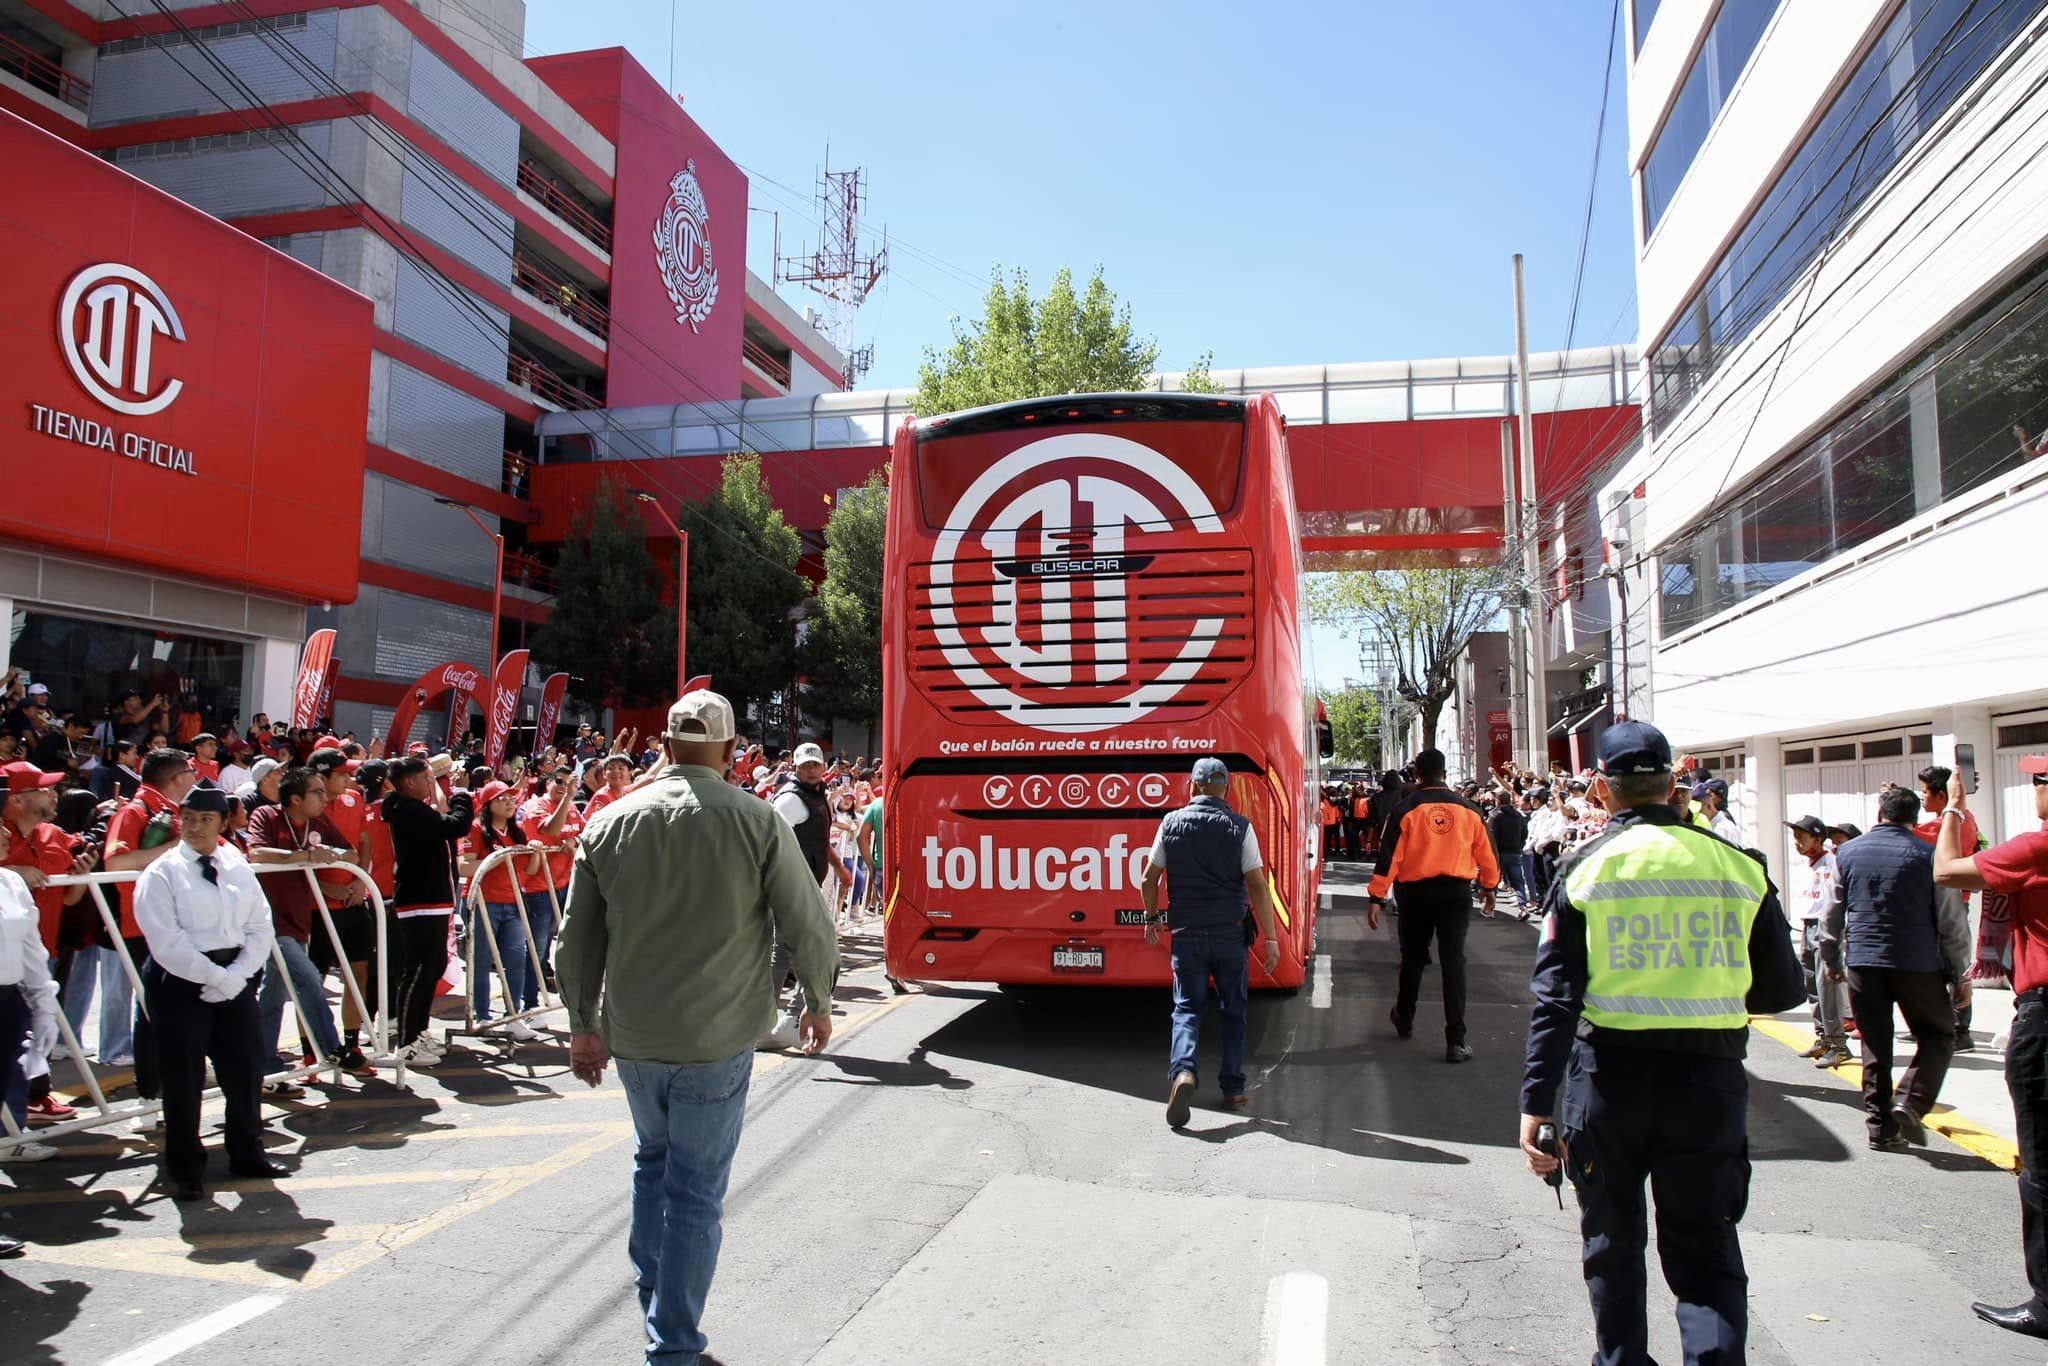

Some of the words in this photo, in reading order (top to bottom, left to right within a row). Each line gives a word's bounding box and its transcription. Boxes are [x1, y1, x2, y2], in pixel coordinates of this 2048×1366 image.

[32, 404, 115, 452] TIENDA
[123, 432, 198, 476] OFICIAL
[1031, 559, 1119, 573] BUSSCAR
[939, 740, 970, 753] Que
[973, 739, 988, 752] el
[990, 739, 1035, 752] balón
[1039, 738, 1086, 751] ruede
[1089, 740, 1101, 750] a
[1104, 737, 1168, 750] nuestro
[1172, 737, 1217, 749] favor
[1057, 952, 1099, 965] 91-RD-1G
[1608, 941, 1745, 970] ESTATAL
